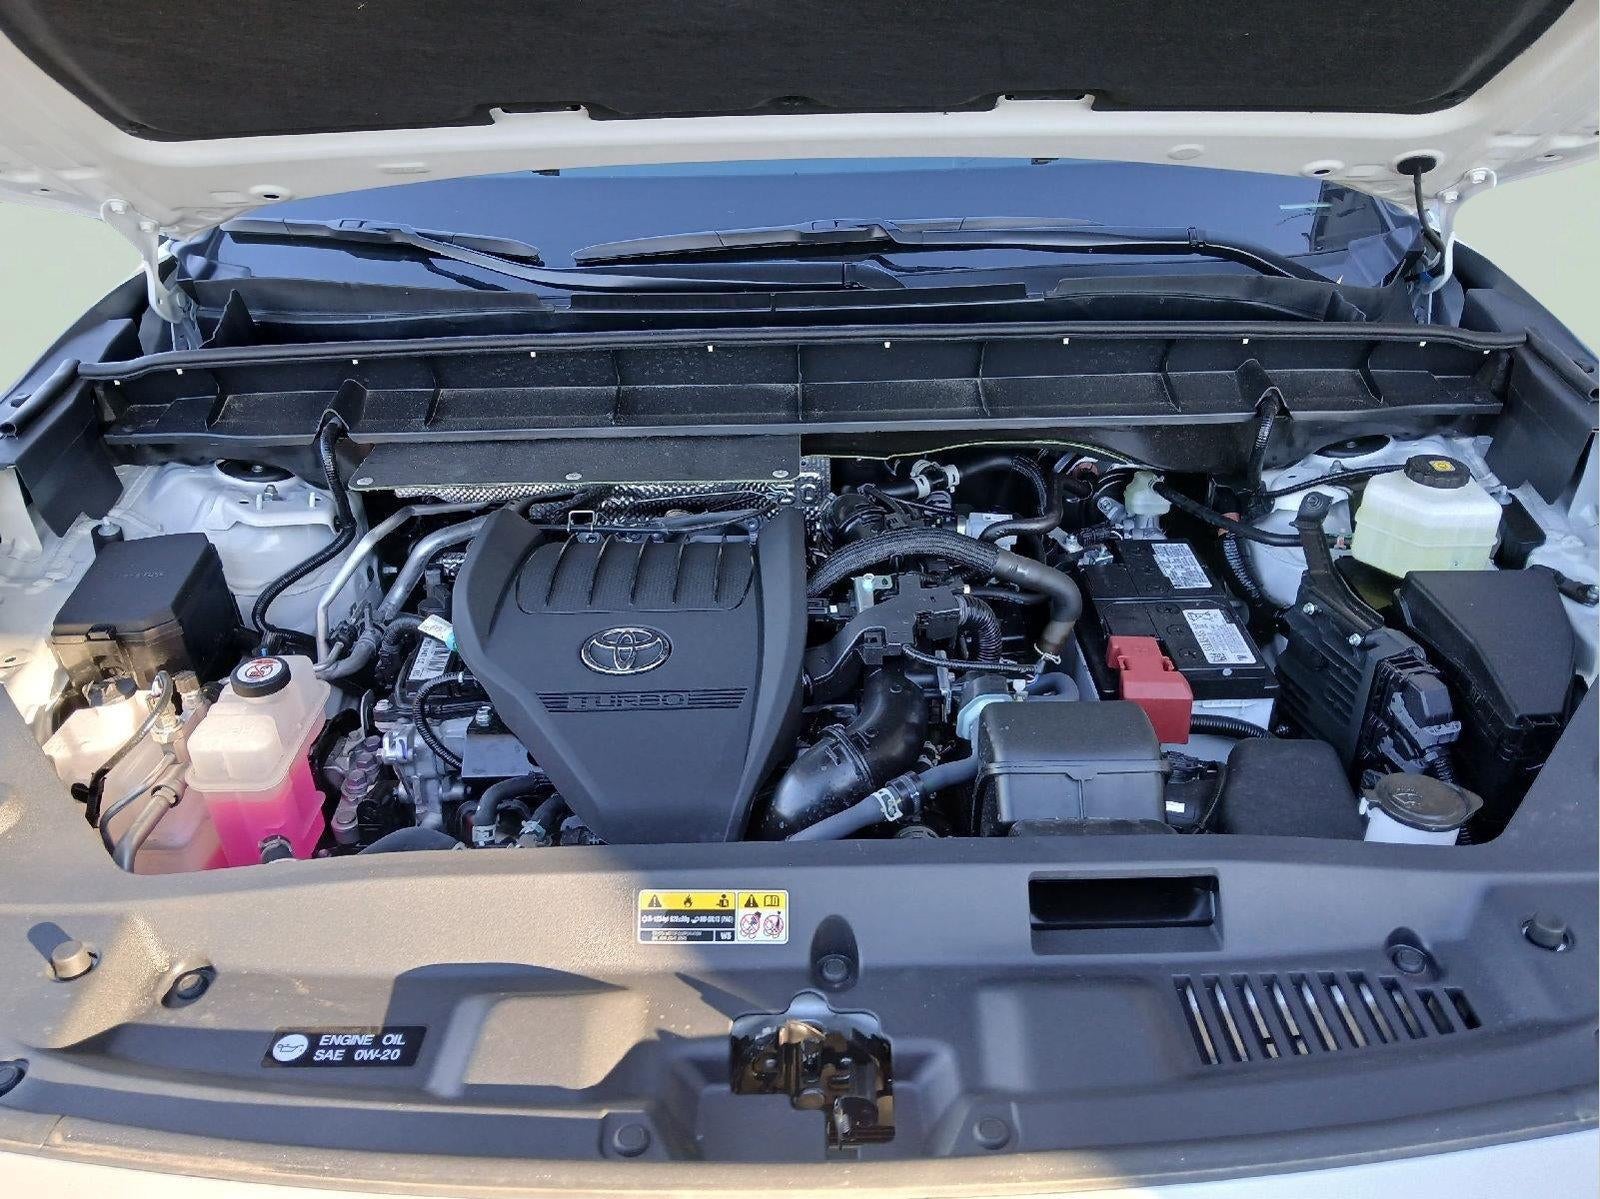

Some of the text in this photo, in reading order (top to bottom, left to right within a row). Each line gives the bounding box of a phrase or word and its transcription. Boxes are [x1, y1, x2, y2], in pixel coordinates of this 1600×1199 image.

[570, 693, 687, 708] TURBO
[319, 1033, 406, 1046] ENGINE OIL
[313, 1049, 401, 1061] SAE 0W-20
